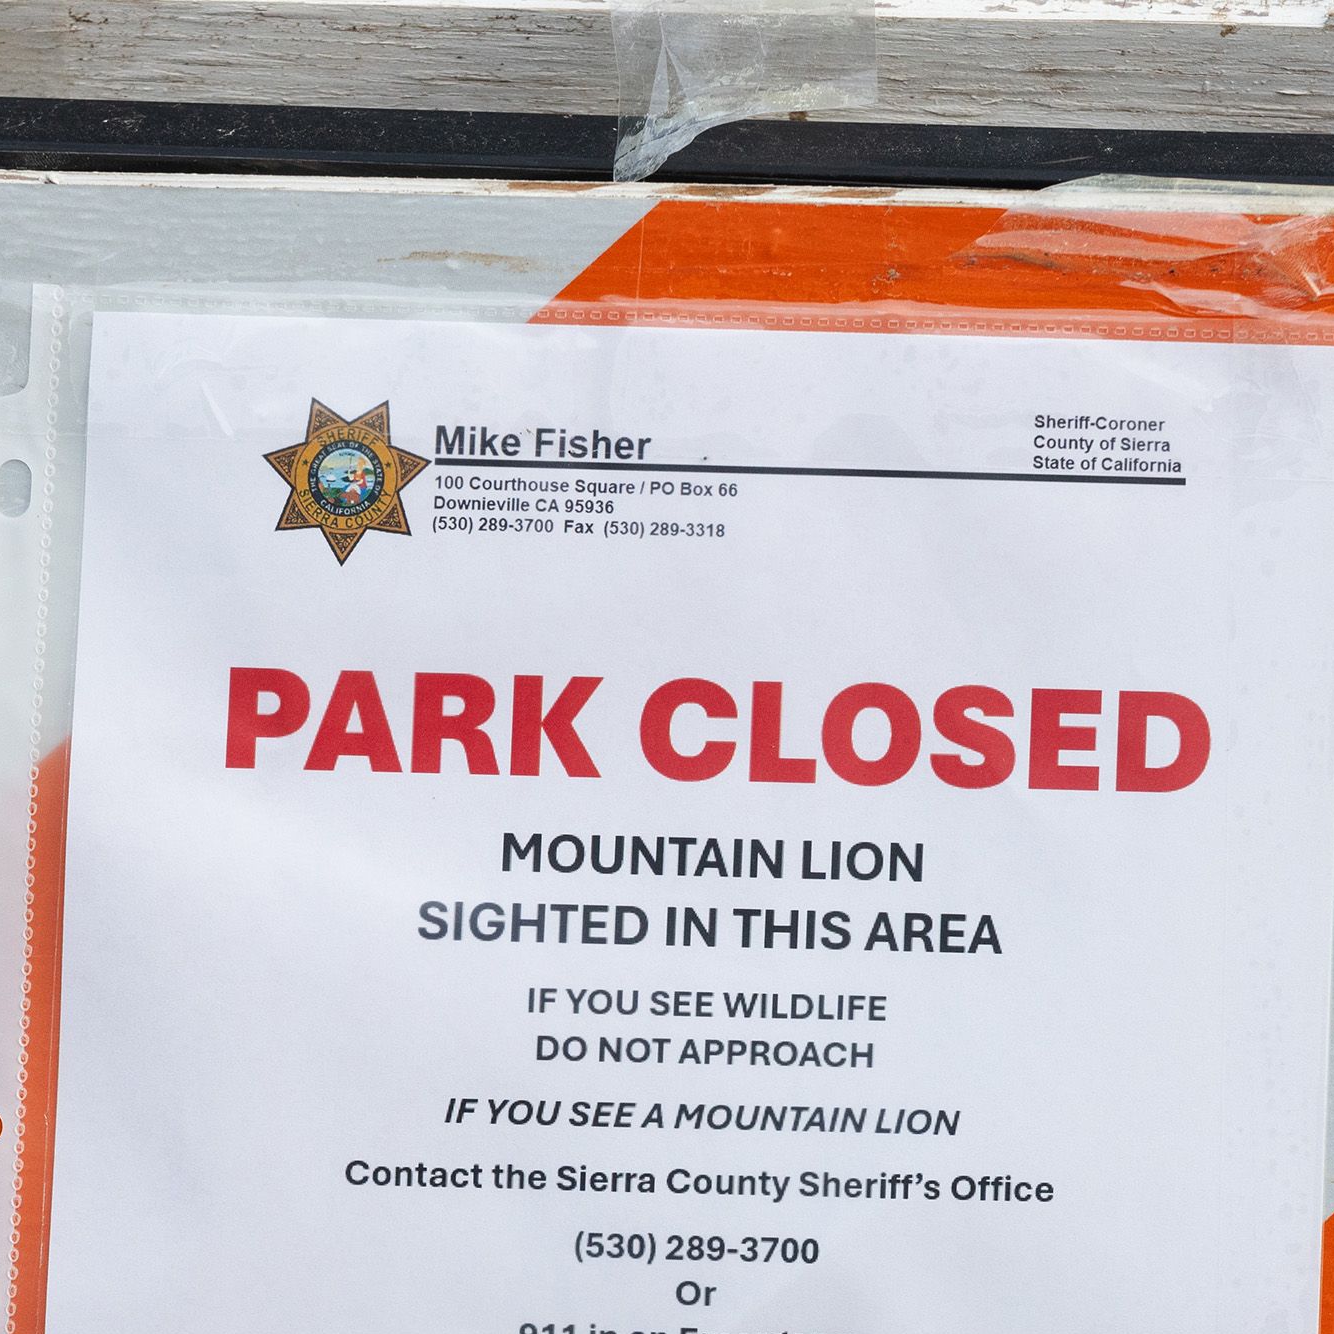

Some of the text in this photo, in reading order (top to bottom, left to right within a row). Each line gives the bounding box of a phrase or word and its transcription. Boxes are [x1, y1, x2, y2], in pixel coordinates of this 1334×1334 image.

[317, 428, 379, 447] SHERIFF
[1034, 414, 1166, 432] Sheriff-Coroner
[434, 424, 652, 461] Mike Fisher
[1033, 434, 1171, 454] County of Sierra
[1032, 455, 1182, 473] State of California
[434, 475, 738, 498] 100 Courthouse Square / PO Box 66
[299, 488, 392, 528] SIERRA COUNTY
[320, 500, 371, 515] CALIFORNIA
[433, 495, 615, 514] Downieville CA 95936
[432, 515, 725, 539] (530) 289-3700 Fax (530) 289-3318
[225, 666, 1212, 793] PARK CLOSED
[501, 832, 924, 883] MOUNTAIN LION
[417, 900, 1003, 955] SIGHTED IN THIS AREA
[528, 987, 887, 1022] IF YOU SEE WILDLIFE
[536, 1035, 874, 1069] DO NOT APPROACH
[444, 1097, 961, 1136] IF YOU SEE A MOUNTAIN LION
[344, 1159, 483, 1189] Contact
[491, 1163, 547, 1190] the
[556, 1164, 656, 1194] Sierra
[666, 1168, 791, 1204] County
[950, 1174, 1054, 1203] Office
[574, 1230, 820, 1265] (530) 289-3700
[675, 1280, 717, 1307] Or
